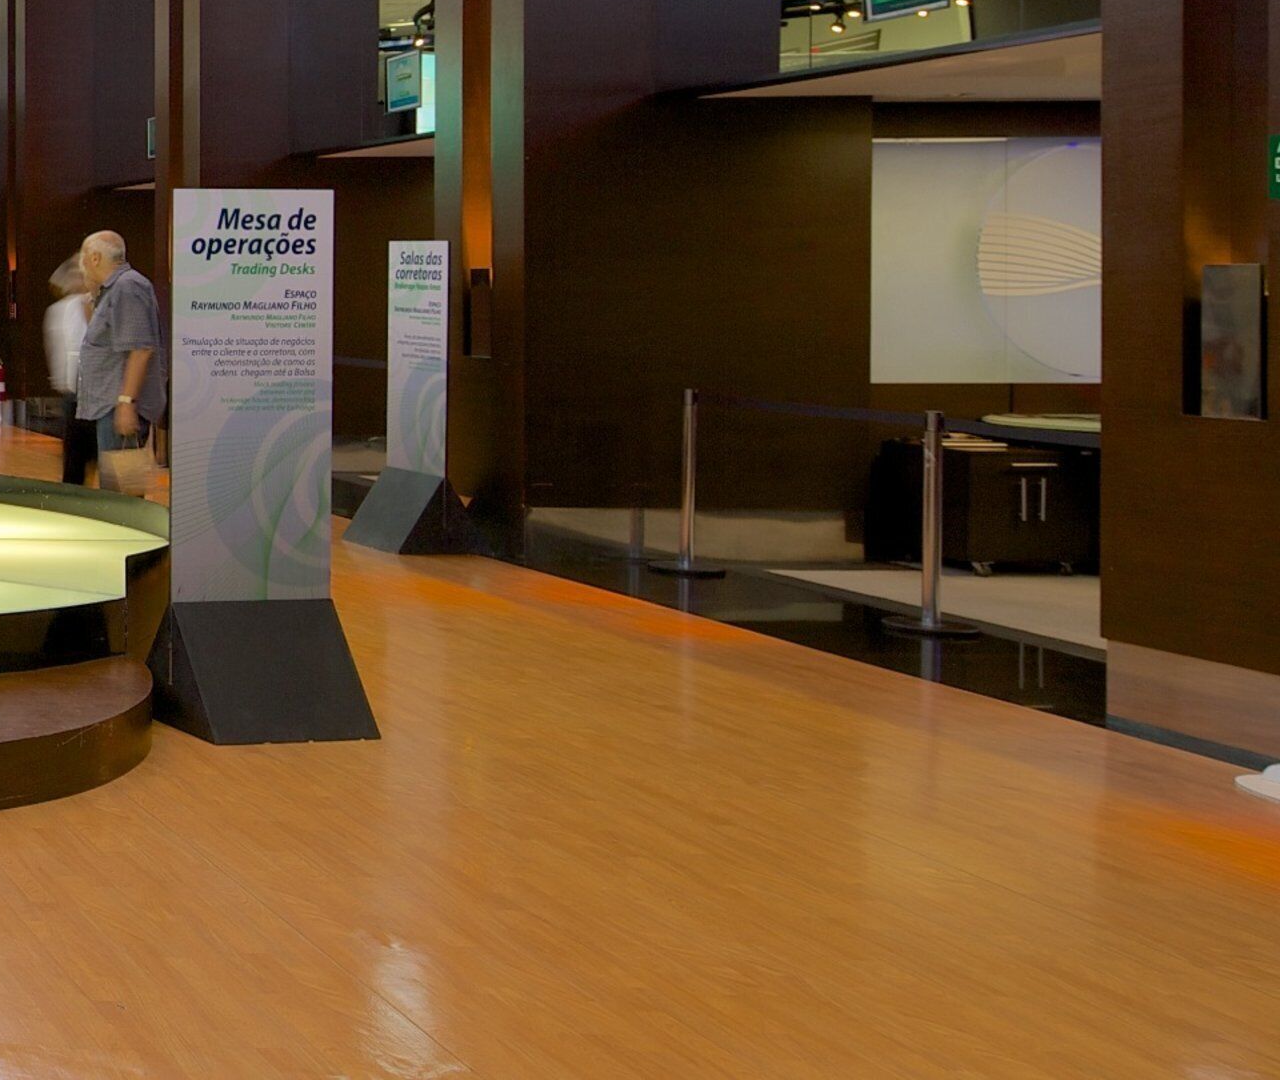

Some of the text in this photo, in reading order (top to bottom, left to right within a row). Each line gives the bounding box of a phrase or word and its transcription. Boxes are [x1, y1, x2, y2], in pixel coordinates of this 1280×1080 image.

[217, 207, 316, 230] Mesa de
[191, 232, 316, 261] operações
[400, 251, 442, 265] Salas das
[230, 263, 315, 277] Trading Desks
[395, 267, 442, 281] corretoras
[182, 337, 315, 347] Simulação de situação de negócios
[219, 348, 245, 356] cliente
[214, 358, 271, 367] demonstração
[272, 358, 282, 366] de
[240, 368, 272, 378] chegam
[294, 368, 315, 377] Bolsa
